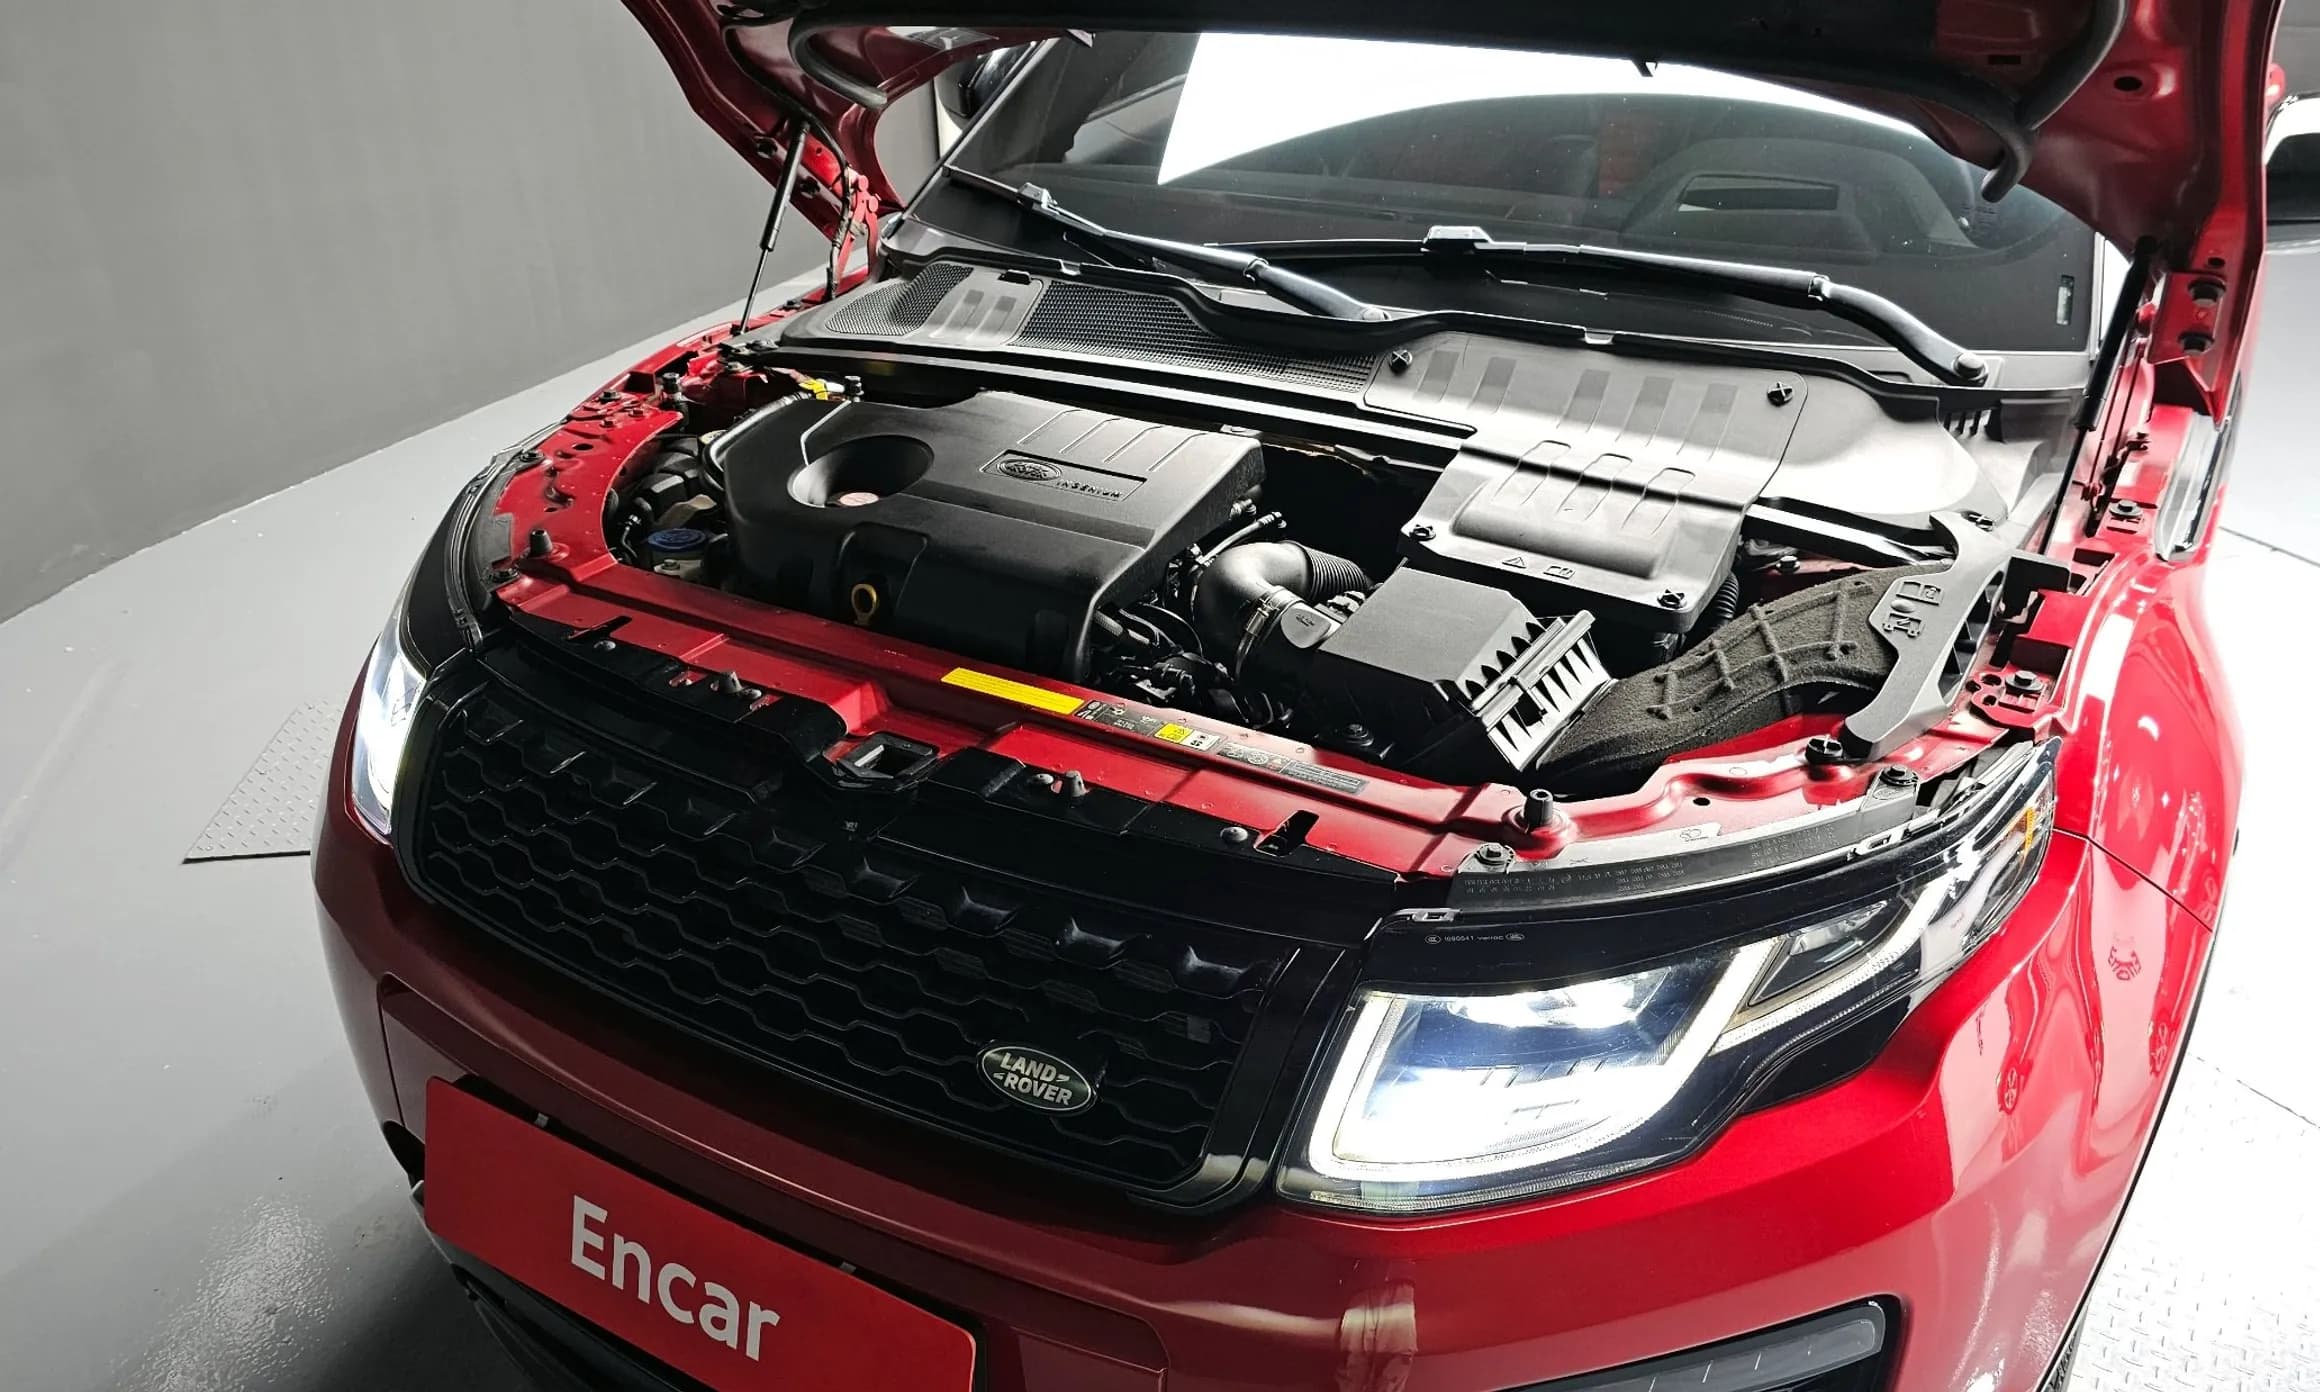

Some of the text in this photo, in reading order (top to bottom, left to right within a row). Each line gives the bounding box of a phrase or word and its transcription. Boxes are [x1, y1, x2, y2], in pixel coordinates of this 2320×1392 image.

[1000, 1052, 1057, 1083] LAND
[1003, 1072, 1073, 1106] ROVER
[570, 1194, 781, 1363] Encar
